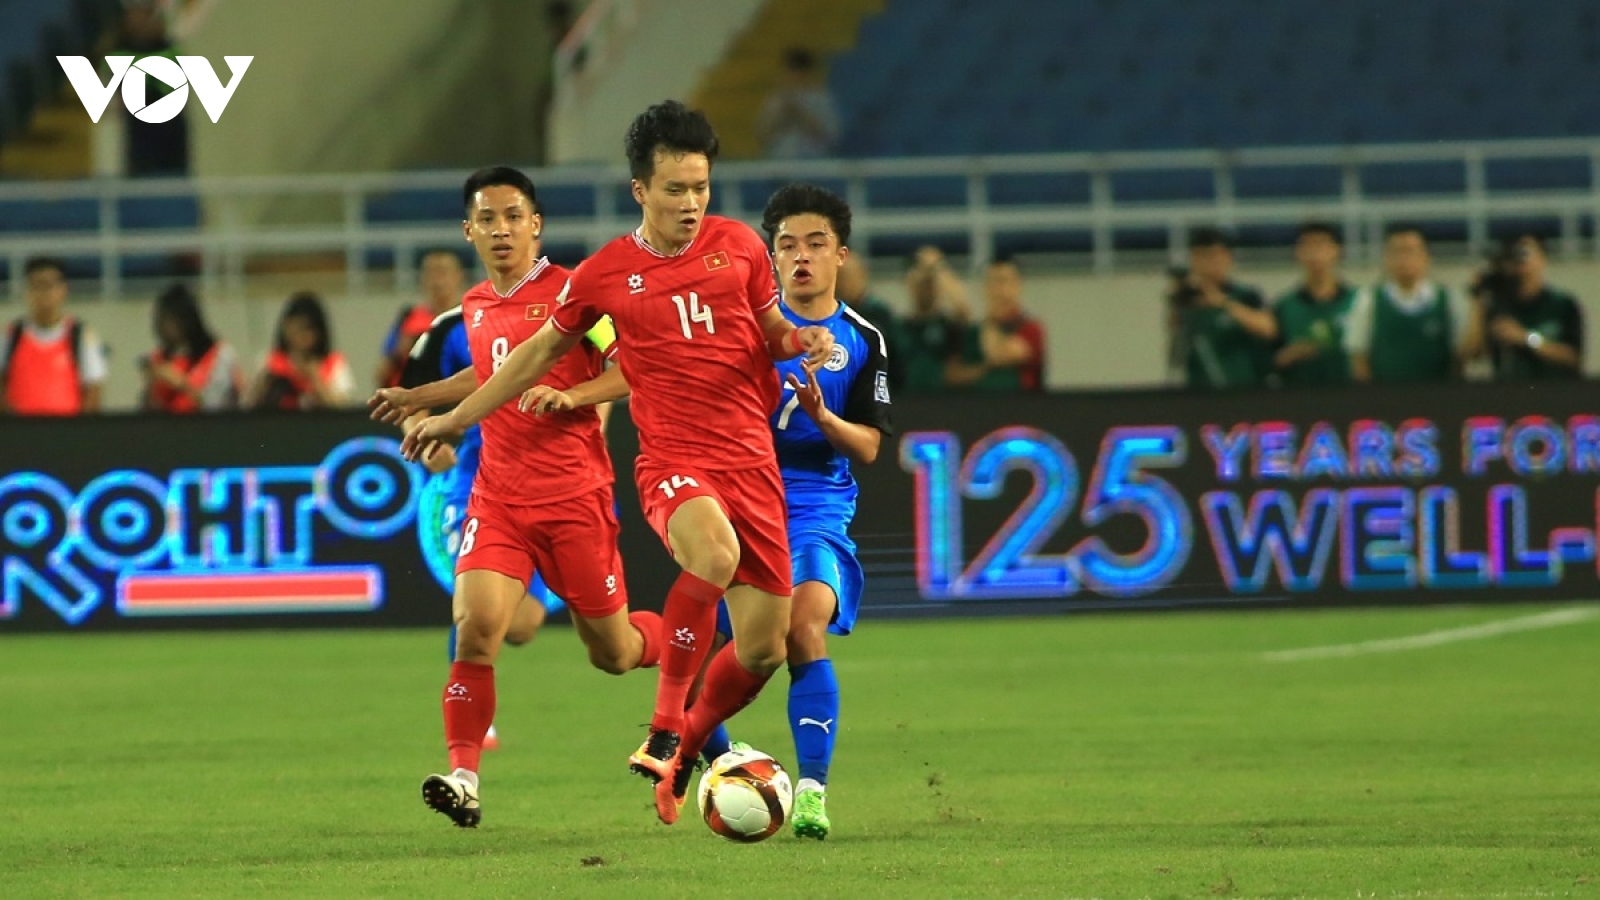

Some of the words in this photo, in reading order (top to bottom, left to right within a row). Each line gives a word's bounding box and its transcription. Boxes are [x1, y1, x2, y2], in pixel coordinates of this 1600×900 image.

[671, 291, 715, 340] 14
[491, 336, 509, 374] 8
[777, 380, 807, 430] 7
[1201, 418, 1440, 478] YEARS
[1461, 415, 1600, 475] FOR
[657, 474, 700, 499] 14
[899, 425, 1193, 597] 125
[0, 436, 424, 625] ROHTO
[458, 516, 479, 557] 8
[1201, 484, 1600, 591] WELL-
